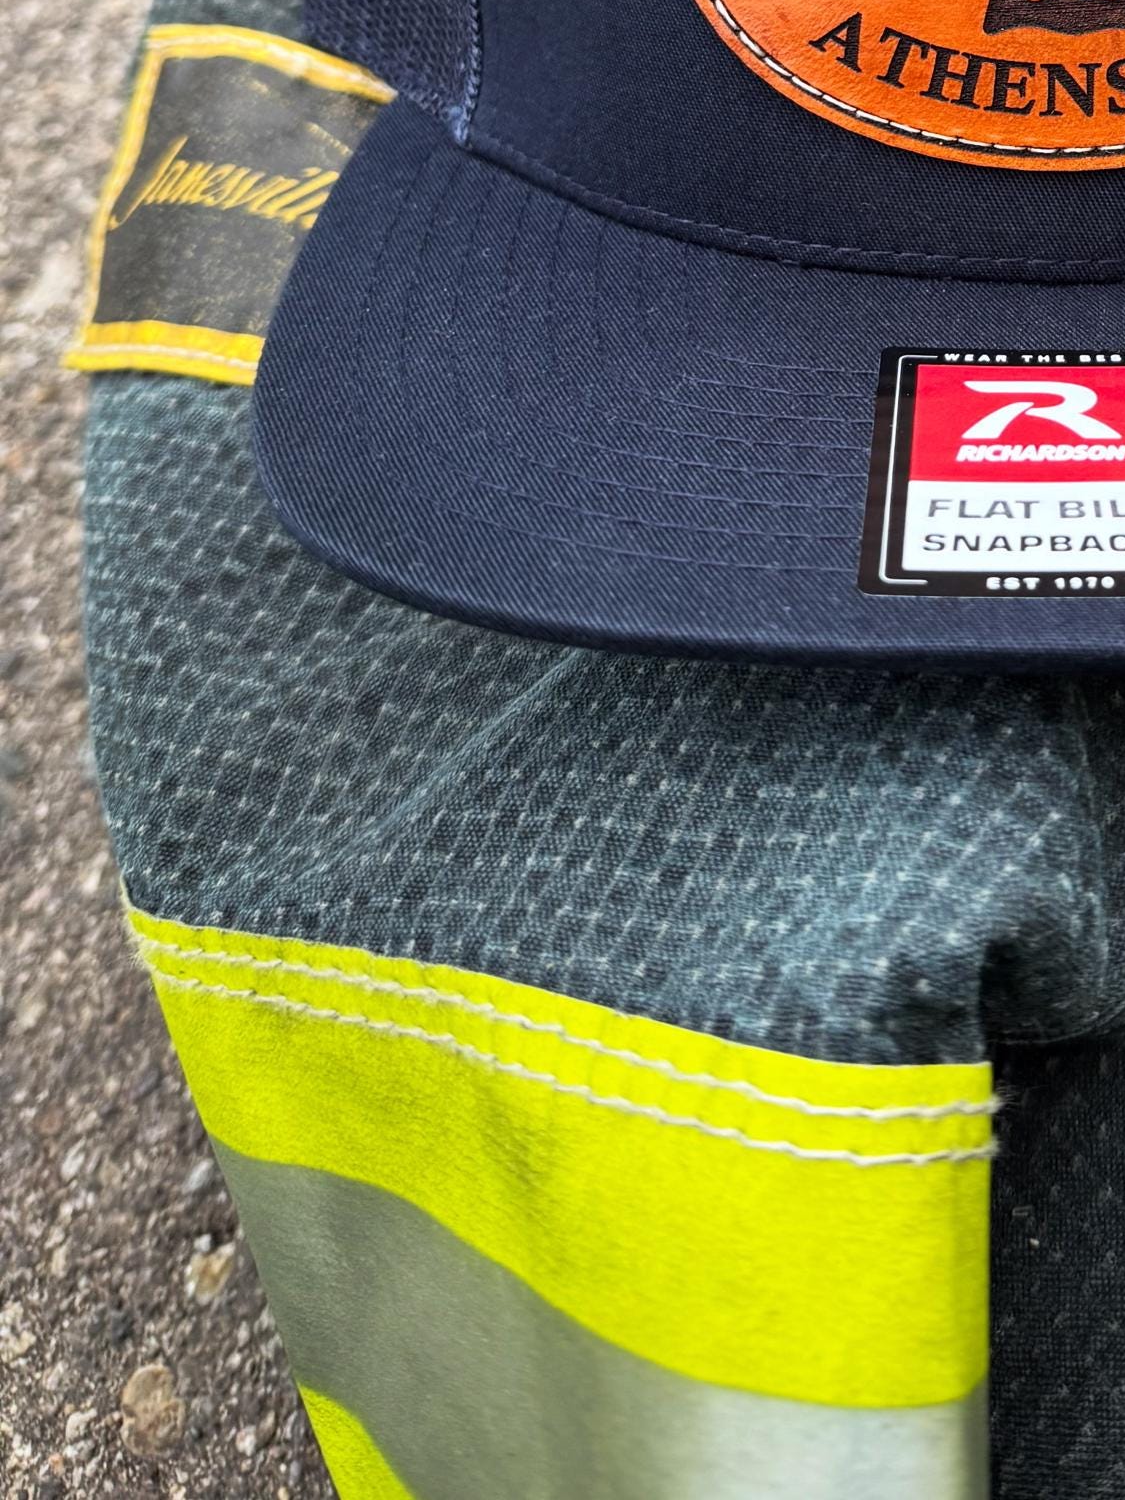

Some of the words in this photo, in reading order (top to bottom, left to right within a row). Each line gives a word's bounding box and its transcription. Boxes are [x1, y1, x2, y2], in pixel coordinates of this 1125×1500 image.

[944, 353, 1007, 363] WEAR
[1021, 354, 1066, 363] THE
[928, 499, 1040, 519] FLAT
[986, 576, 1040, 590] EST
[1055, 576, 1115, 590] 1970
